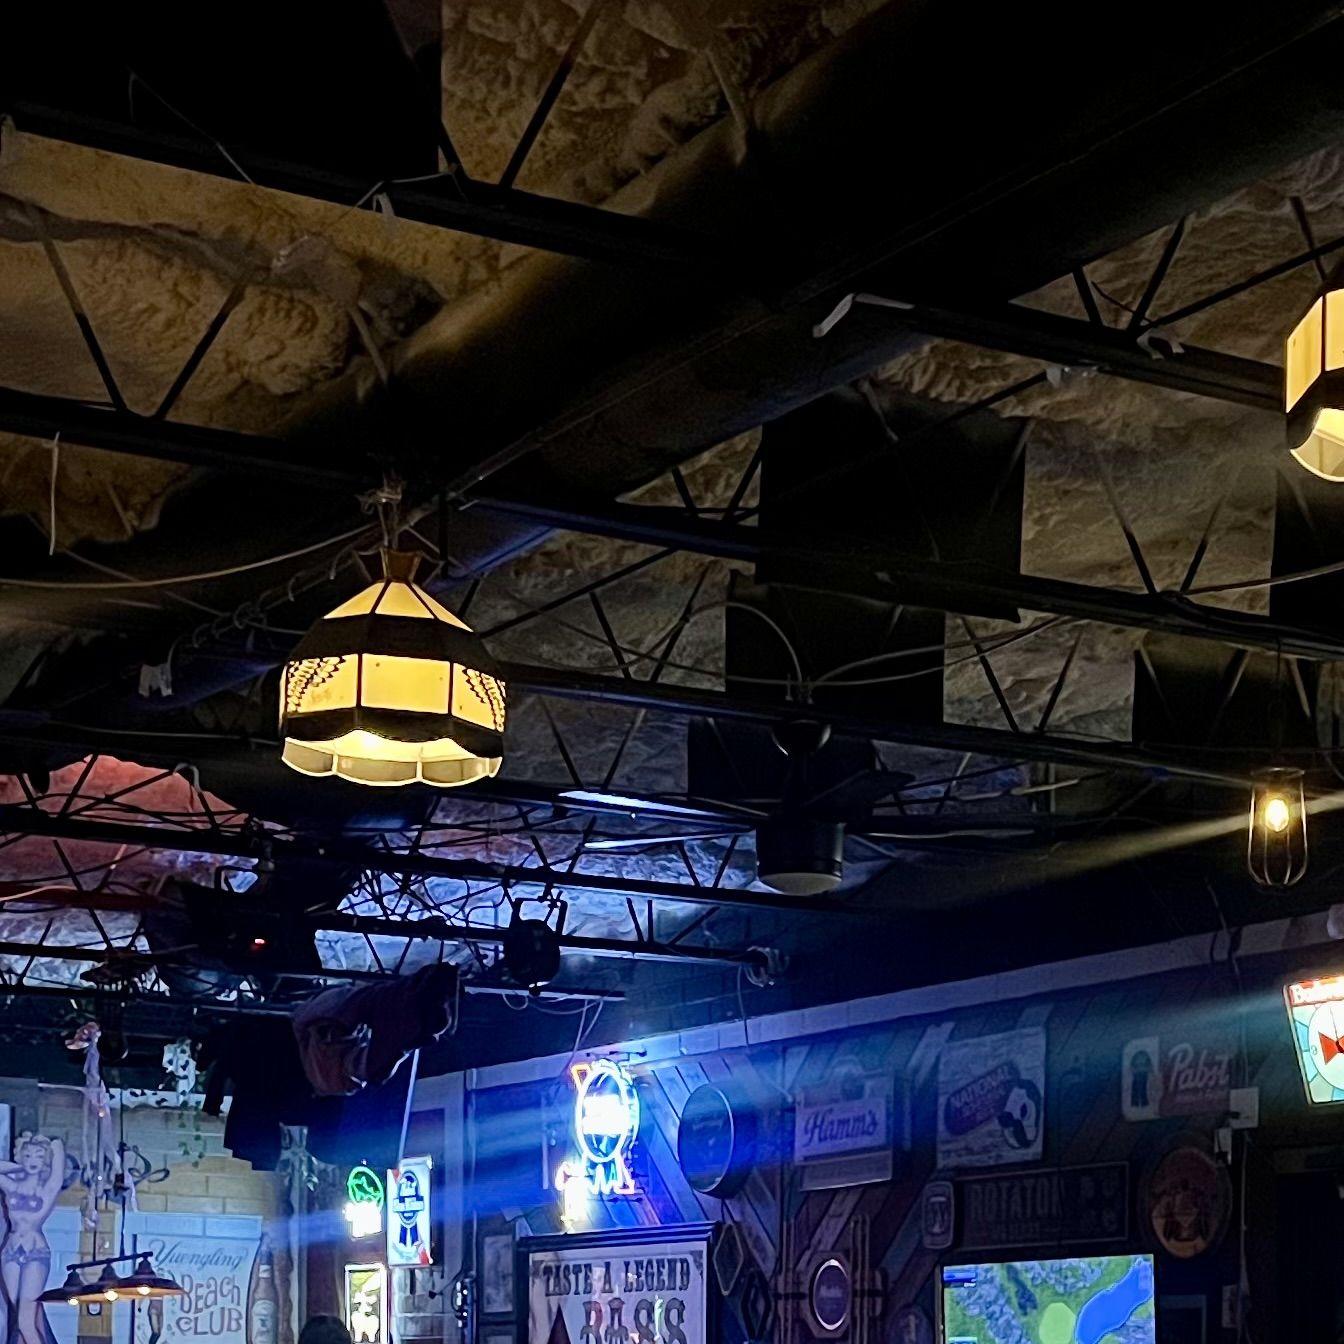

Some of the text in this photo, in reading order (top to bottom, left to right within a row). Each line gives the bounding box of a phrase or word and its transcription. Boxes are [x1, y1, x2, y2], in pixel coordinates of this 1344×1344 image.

[1168, 1042, 1229, 1093] Pabst
[804, 1108, 878, 1147] Hamm's
[149, 1239, 249, 1272] Yuengling
[543, 1258, 690, 1297] TASTE A LEGEND
[176, 1307, 243, 1336] CLUB
